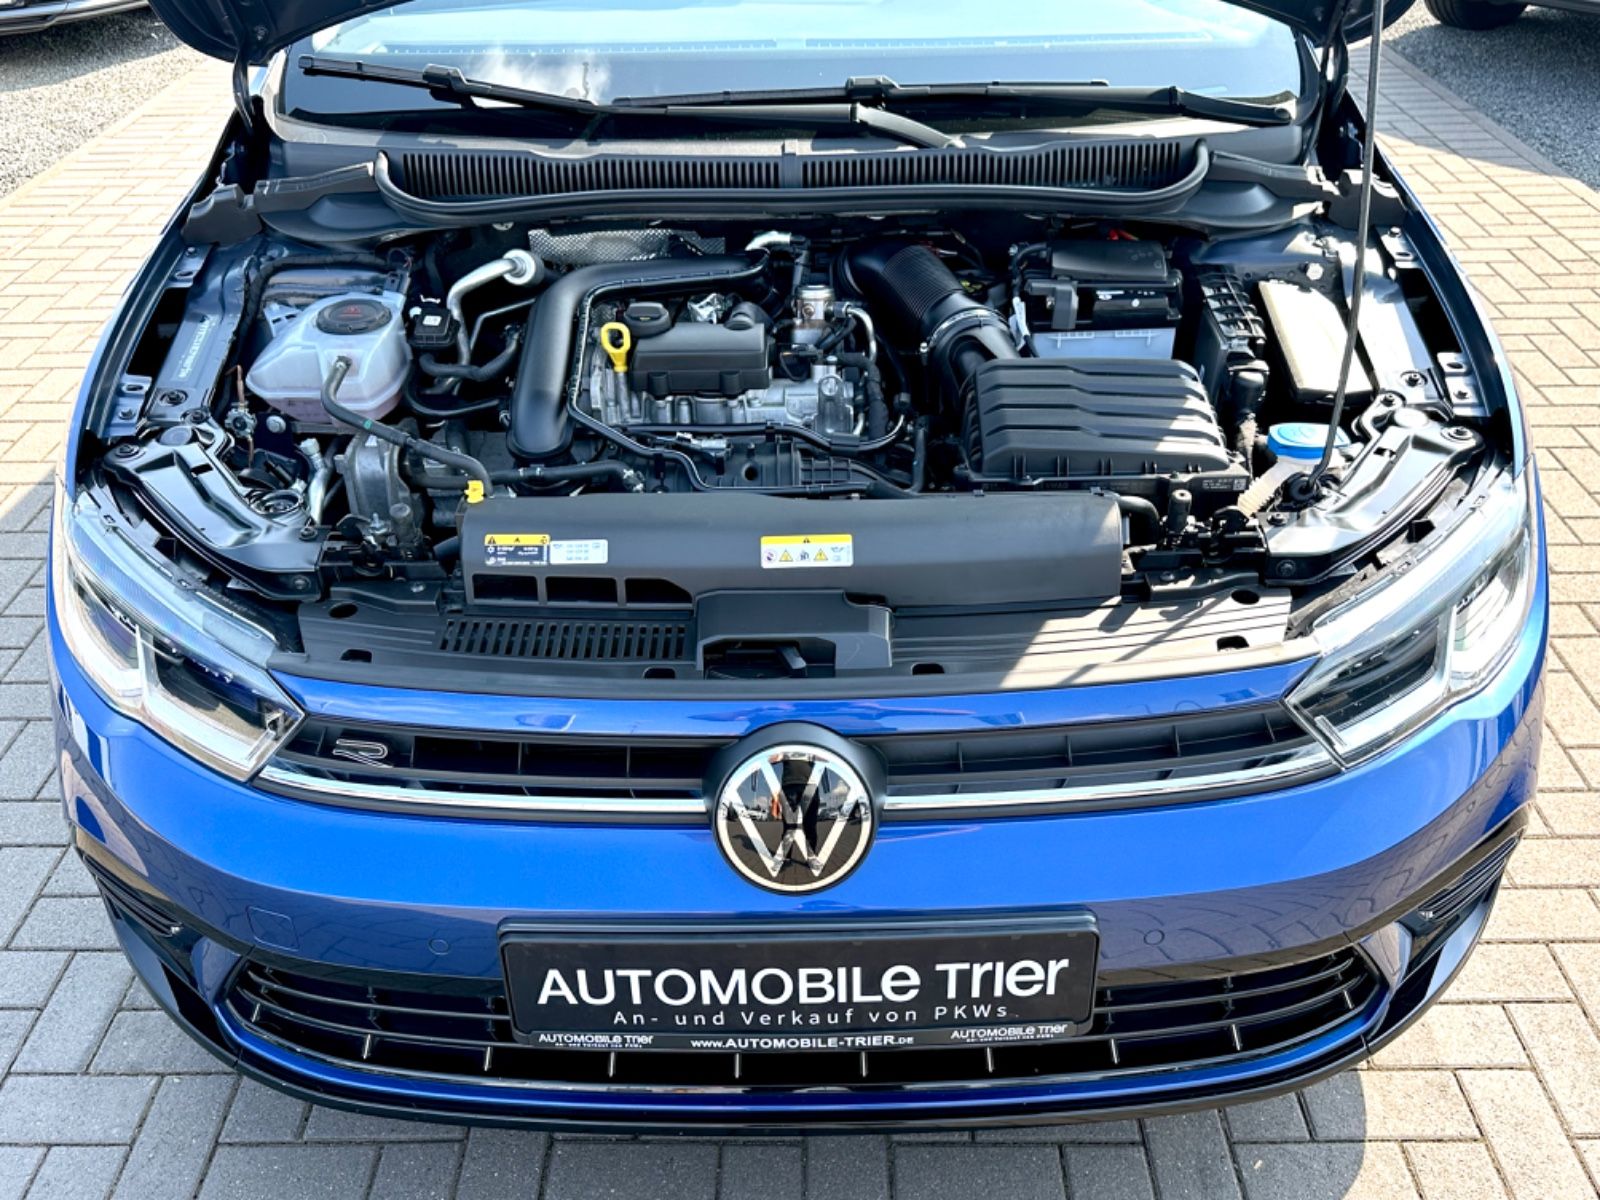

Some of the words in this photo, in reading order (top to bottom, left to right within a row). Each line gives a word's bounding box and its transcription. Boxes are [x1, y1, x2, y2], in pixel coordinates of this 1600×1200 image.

[613, 1011, 658, 1025] An-
[675, 1010, 725, 1025] und
[740, 1008, 854, 1026] Verkauf
[868, 1009, 917, 1023] von
